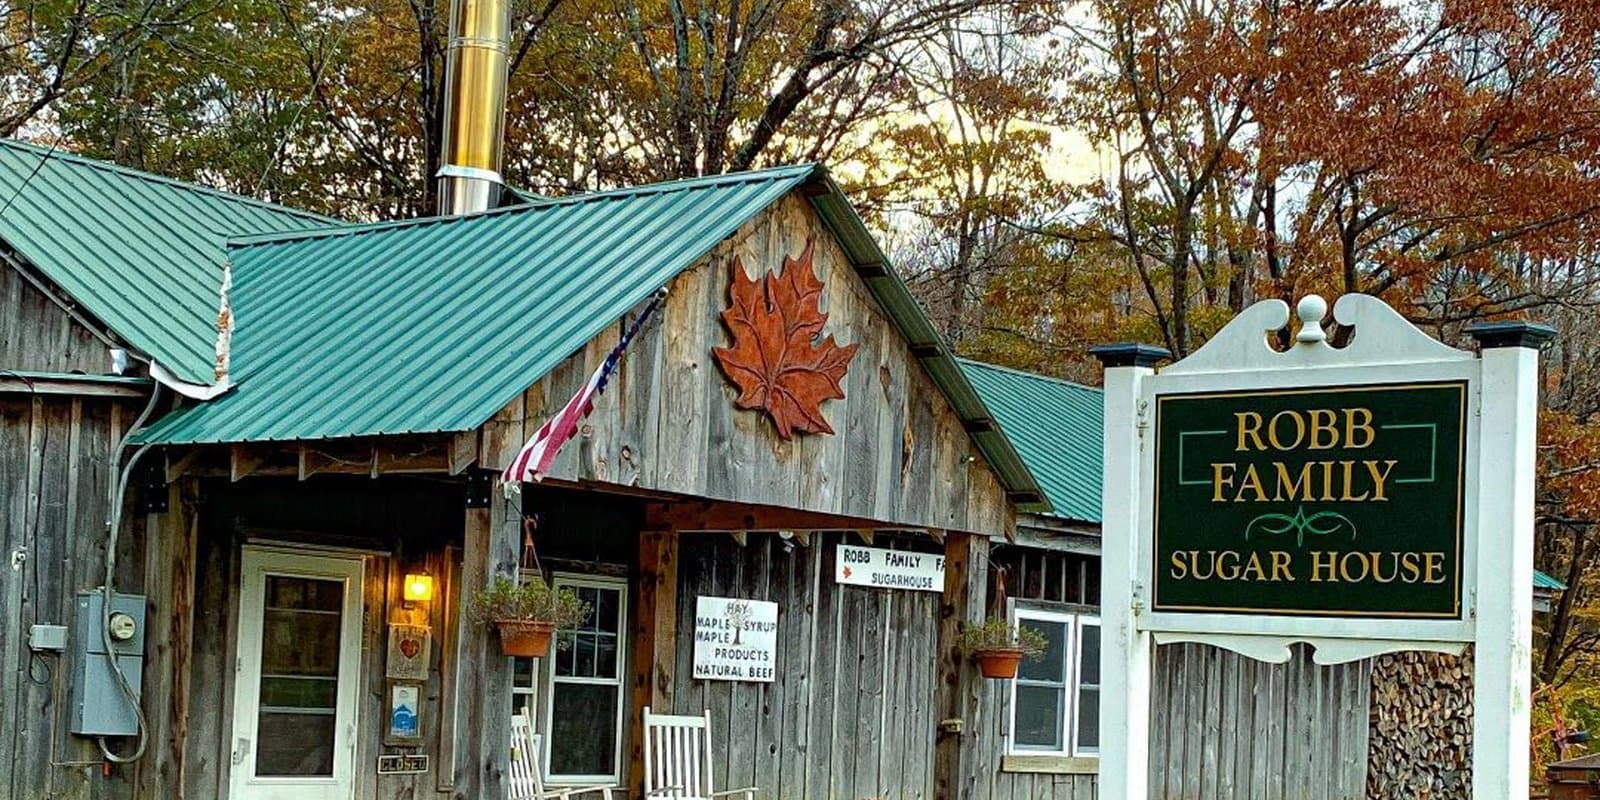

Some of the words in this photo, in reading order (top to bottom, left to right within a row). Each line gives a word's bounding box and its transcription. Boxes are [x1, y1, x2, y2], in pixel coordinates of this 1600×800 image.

[1234, 407, 1376, 452] ROBB
[1210, 460, 1398, 502] FAMILY
[843, 549, 871, 564] ROBB
[885, 552, 921, 568] FAMILY
[1170, 550, 1296, 582] SUGAR
[1309, 551, 1447, 584] HOUSE
[871, 572, 933, 588] SUGARHOUSE
[727, 602, 748, 614] HAY
[697, 617, 730, 630] MAPLE
[743, 620, 776, 632] SYRUP
[696, 631, 730, 644] MAPLE
[715, 648, 769, 661] PRODUCTS
[696, 664, 742, 677] NATURAL
[749, 667, 773, 678] BEEF
[381, 759, 426, 770] CLOSED
